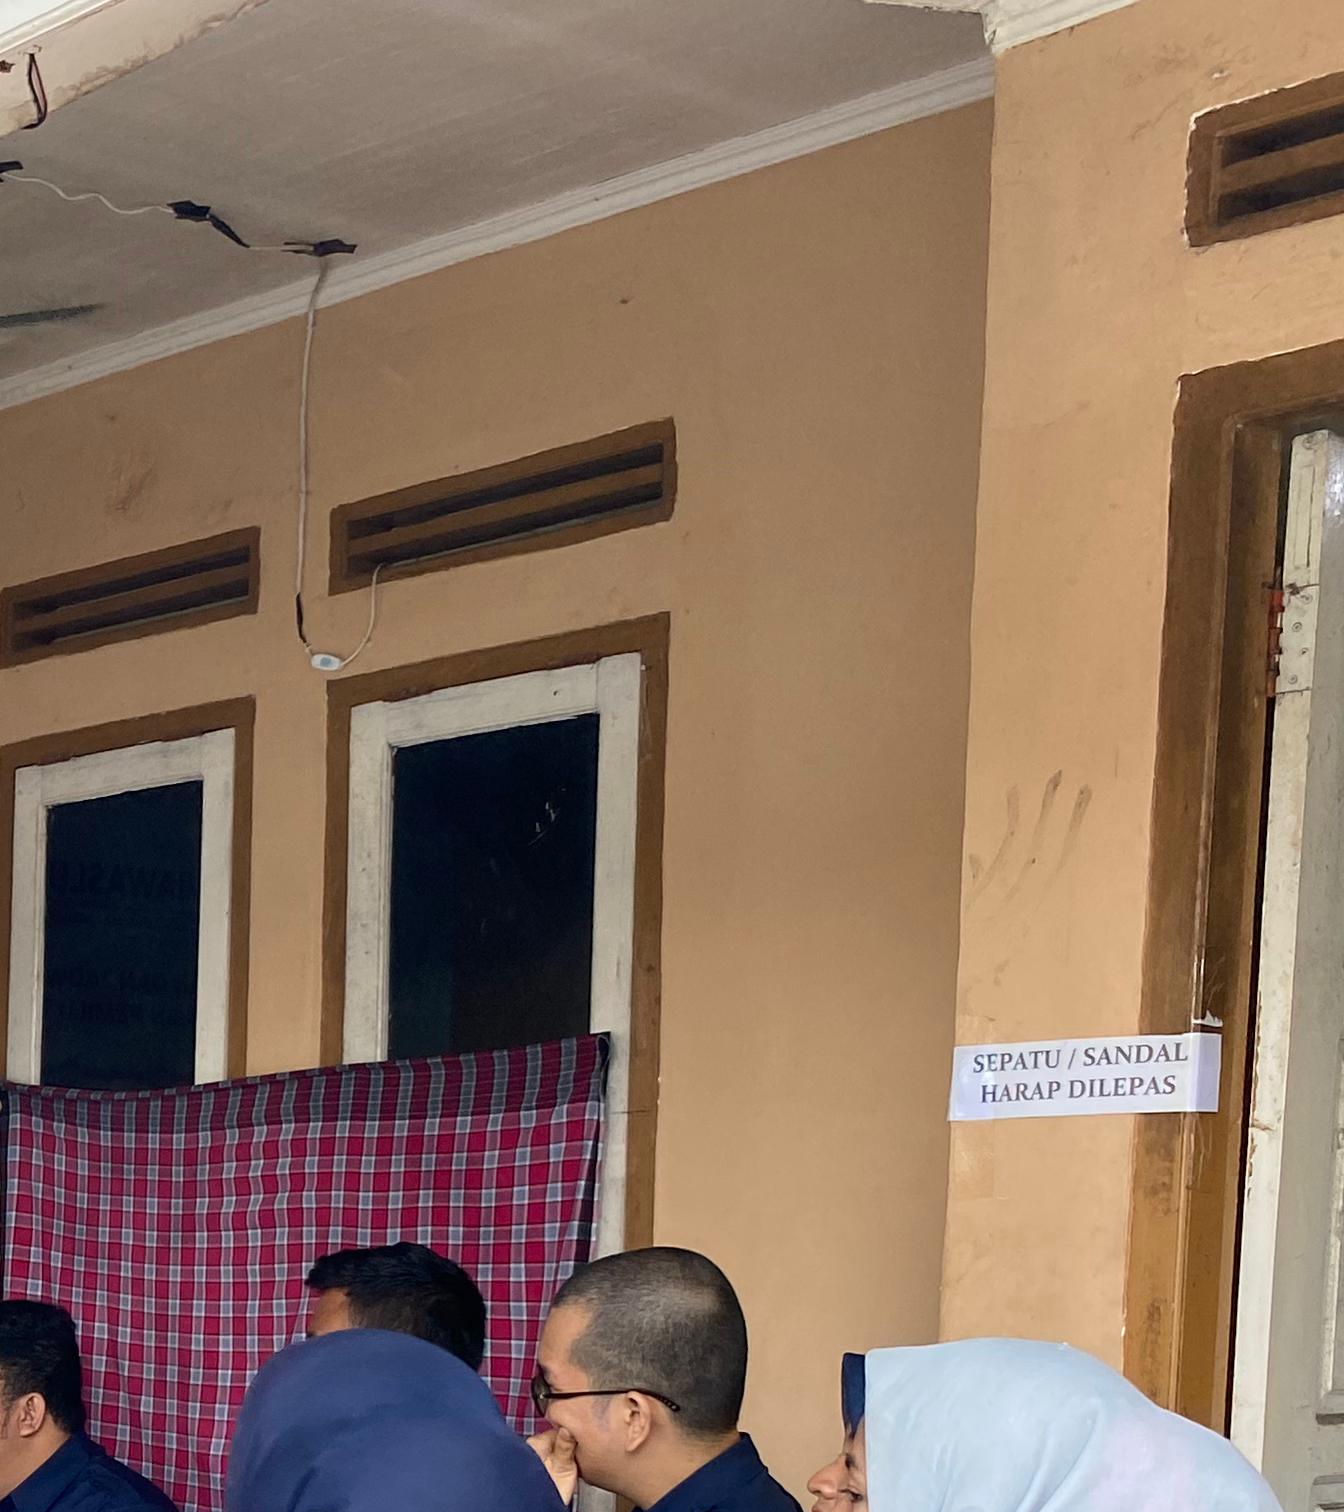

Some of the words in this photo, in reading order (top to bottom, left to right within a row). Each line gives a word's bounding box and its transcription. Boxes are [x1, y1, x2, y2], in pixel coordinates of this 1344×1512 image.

[973, 1049, 1061, 1073] SEPATU
[1068, 1048, 1076, 1069] /
[1083, 1042, 1188, 1066] SANDAL
[981, 1080, 1060, 1103] HARAP
[1068, 1075, 1176, 1098] DILEPAS
